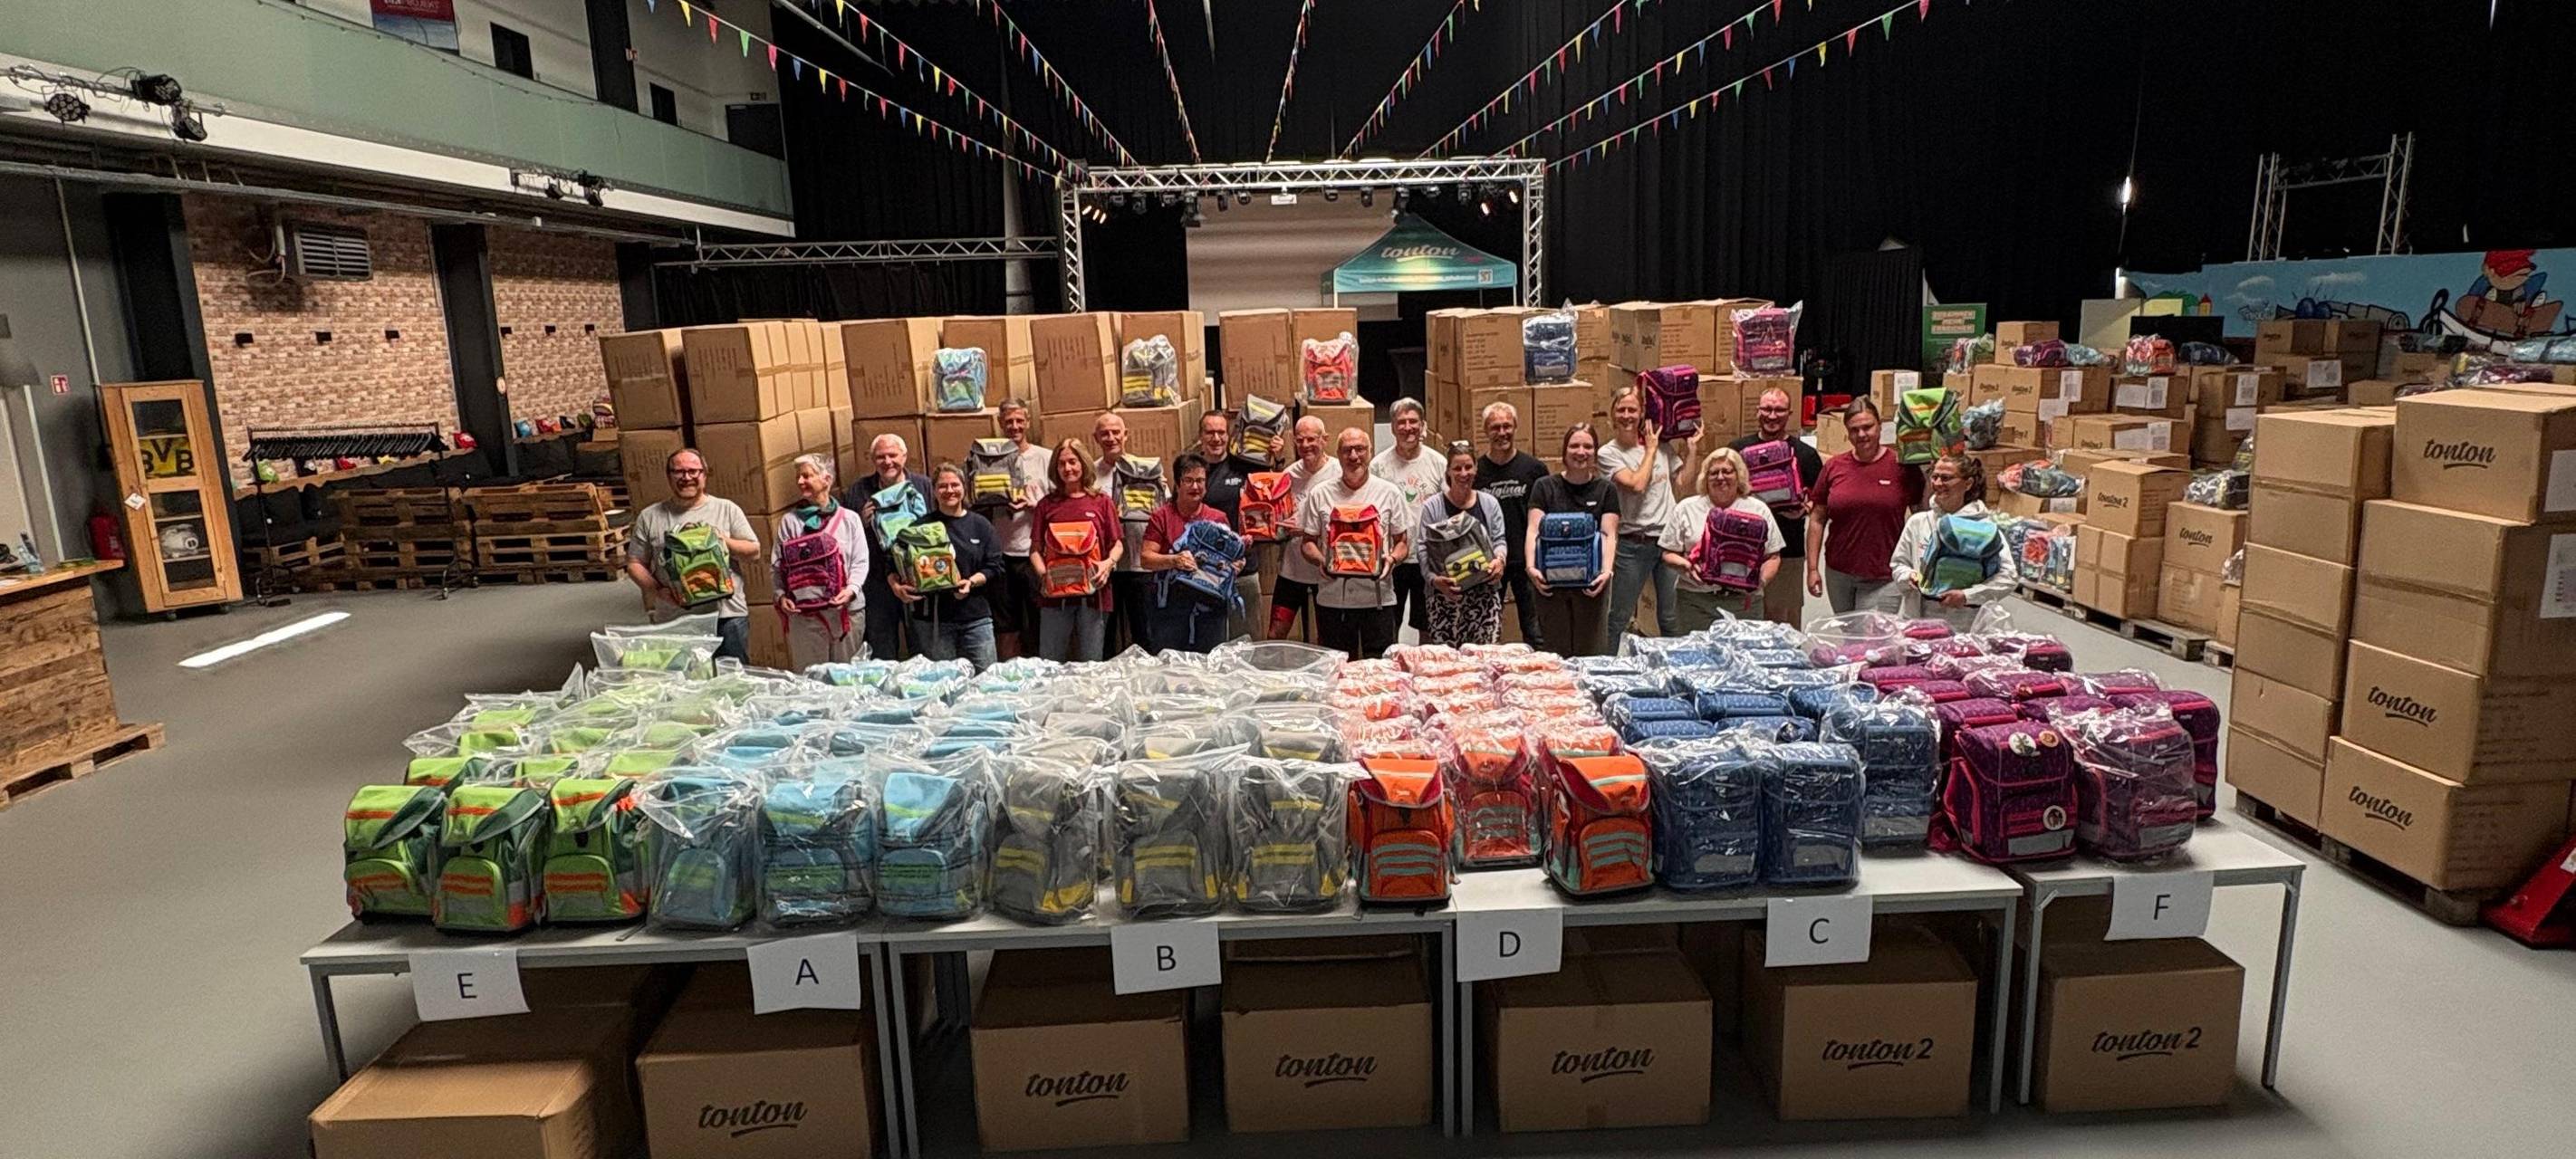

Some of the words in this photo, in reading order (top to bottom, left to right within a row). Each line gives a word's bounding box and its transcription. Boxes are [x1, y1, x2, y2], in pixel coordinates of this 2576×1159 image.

[1381, 244, 1460, 259] tonton
[140, 438, 194, 473] BVB
[2423, 438, 2496, 465] tonton
[2179, 527, 2214, 545] tonton
[2367, 685, 2438, 723] tonton
[2349, 786, 2414, 828] tonton
[2154, 894, 2170, 920] F
[1809, 918, 1829, 944] C
[1157, 945, 1177, 972] B
[1499, 932, 1521, 958] D
[795, 958, 820, 986] A
[457, 972, 476, 1000] E
[1821, 1039, 1915, 1061] tonton
[1916, 1038, 1934, 1059] 2
[2091, 1029, 2182, 1053] tonton
[2185, 1026, 2202, 1049] 2
[1274, 1052, 1378, 1078] tonton
[1552, 1046, 1655, 1076] tonton
[1025, 1070, 1130, 1098] tonton
[698, 1100, 809, 1129] tonton
